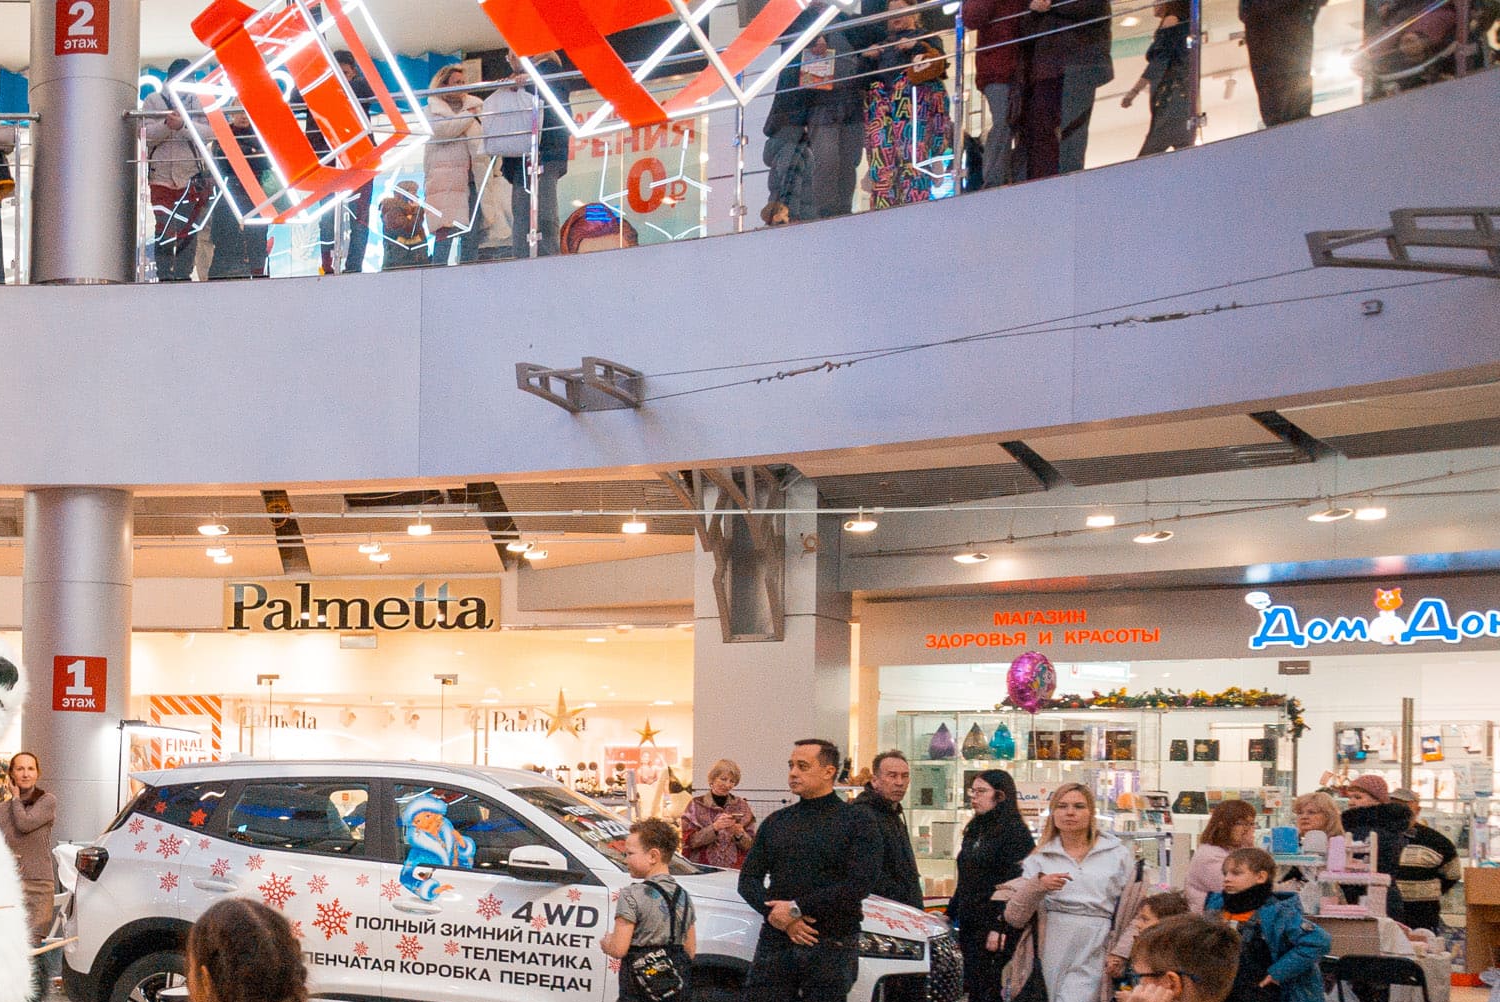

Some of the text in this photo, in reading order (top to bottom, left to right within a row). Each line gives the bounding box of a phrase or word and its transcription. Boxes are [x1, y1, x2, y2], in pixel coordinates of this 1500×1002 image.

[68, 1, 94, 36] 2
[63, 39, 98, 49] этаж
[568, 119, 696, 160] РЕНИЯ
[227, 582, 493, 630] Palmetta
[993, 609, 1087, 626] МАГАЗИН
[925, 627, 1160, 649] ЗДОРОВЬЯ И КРАСОТЫ
[1252, 606, 1368, 648] Дом
[66, 659, 93, 696] 1
[61, 697, 96, 708] этаж
[166, 738, 205, 752] FINAL
[511, 901, 599, 928] 4 WD
[355, 916, 595, 949] ПОЛНЫЙ ЗИМНИЙ ПАКЕТ
[303, 951, 592, 993] ПЕНЧАТАЯ КОРОБКА ПЕРЕДАЧ
[460, 945, 593, 971] ТЕЛЕМАТИКА
